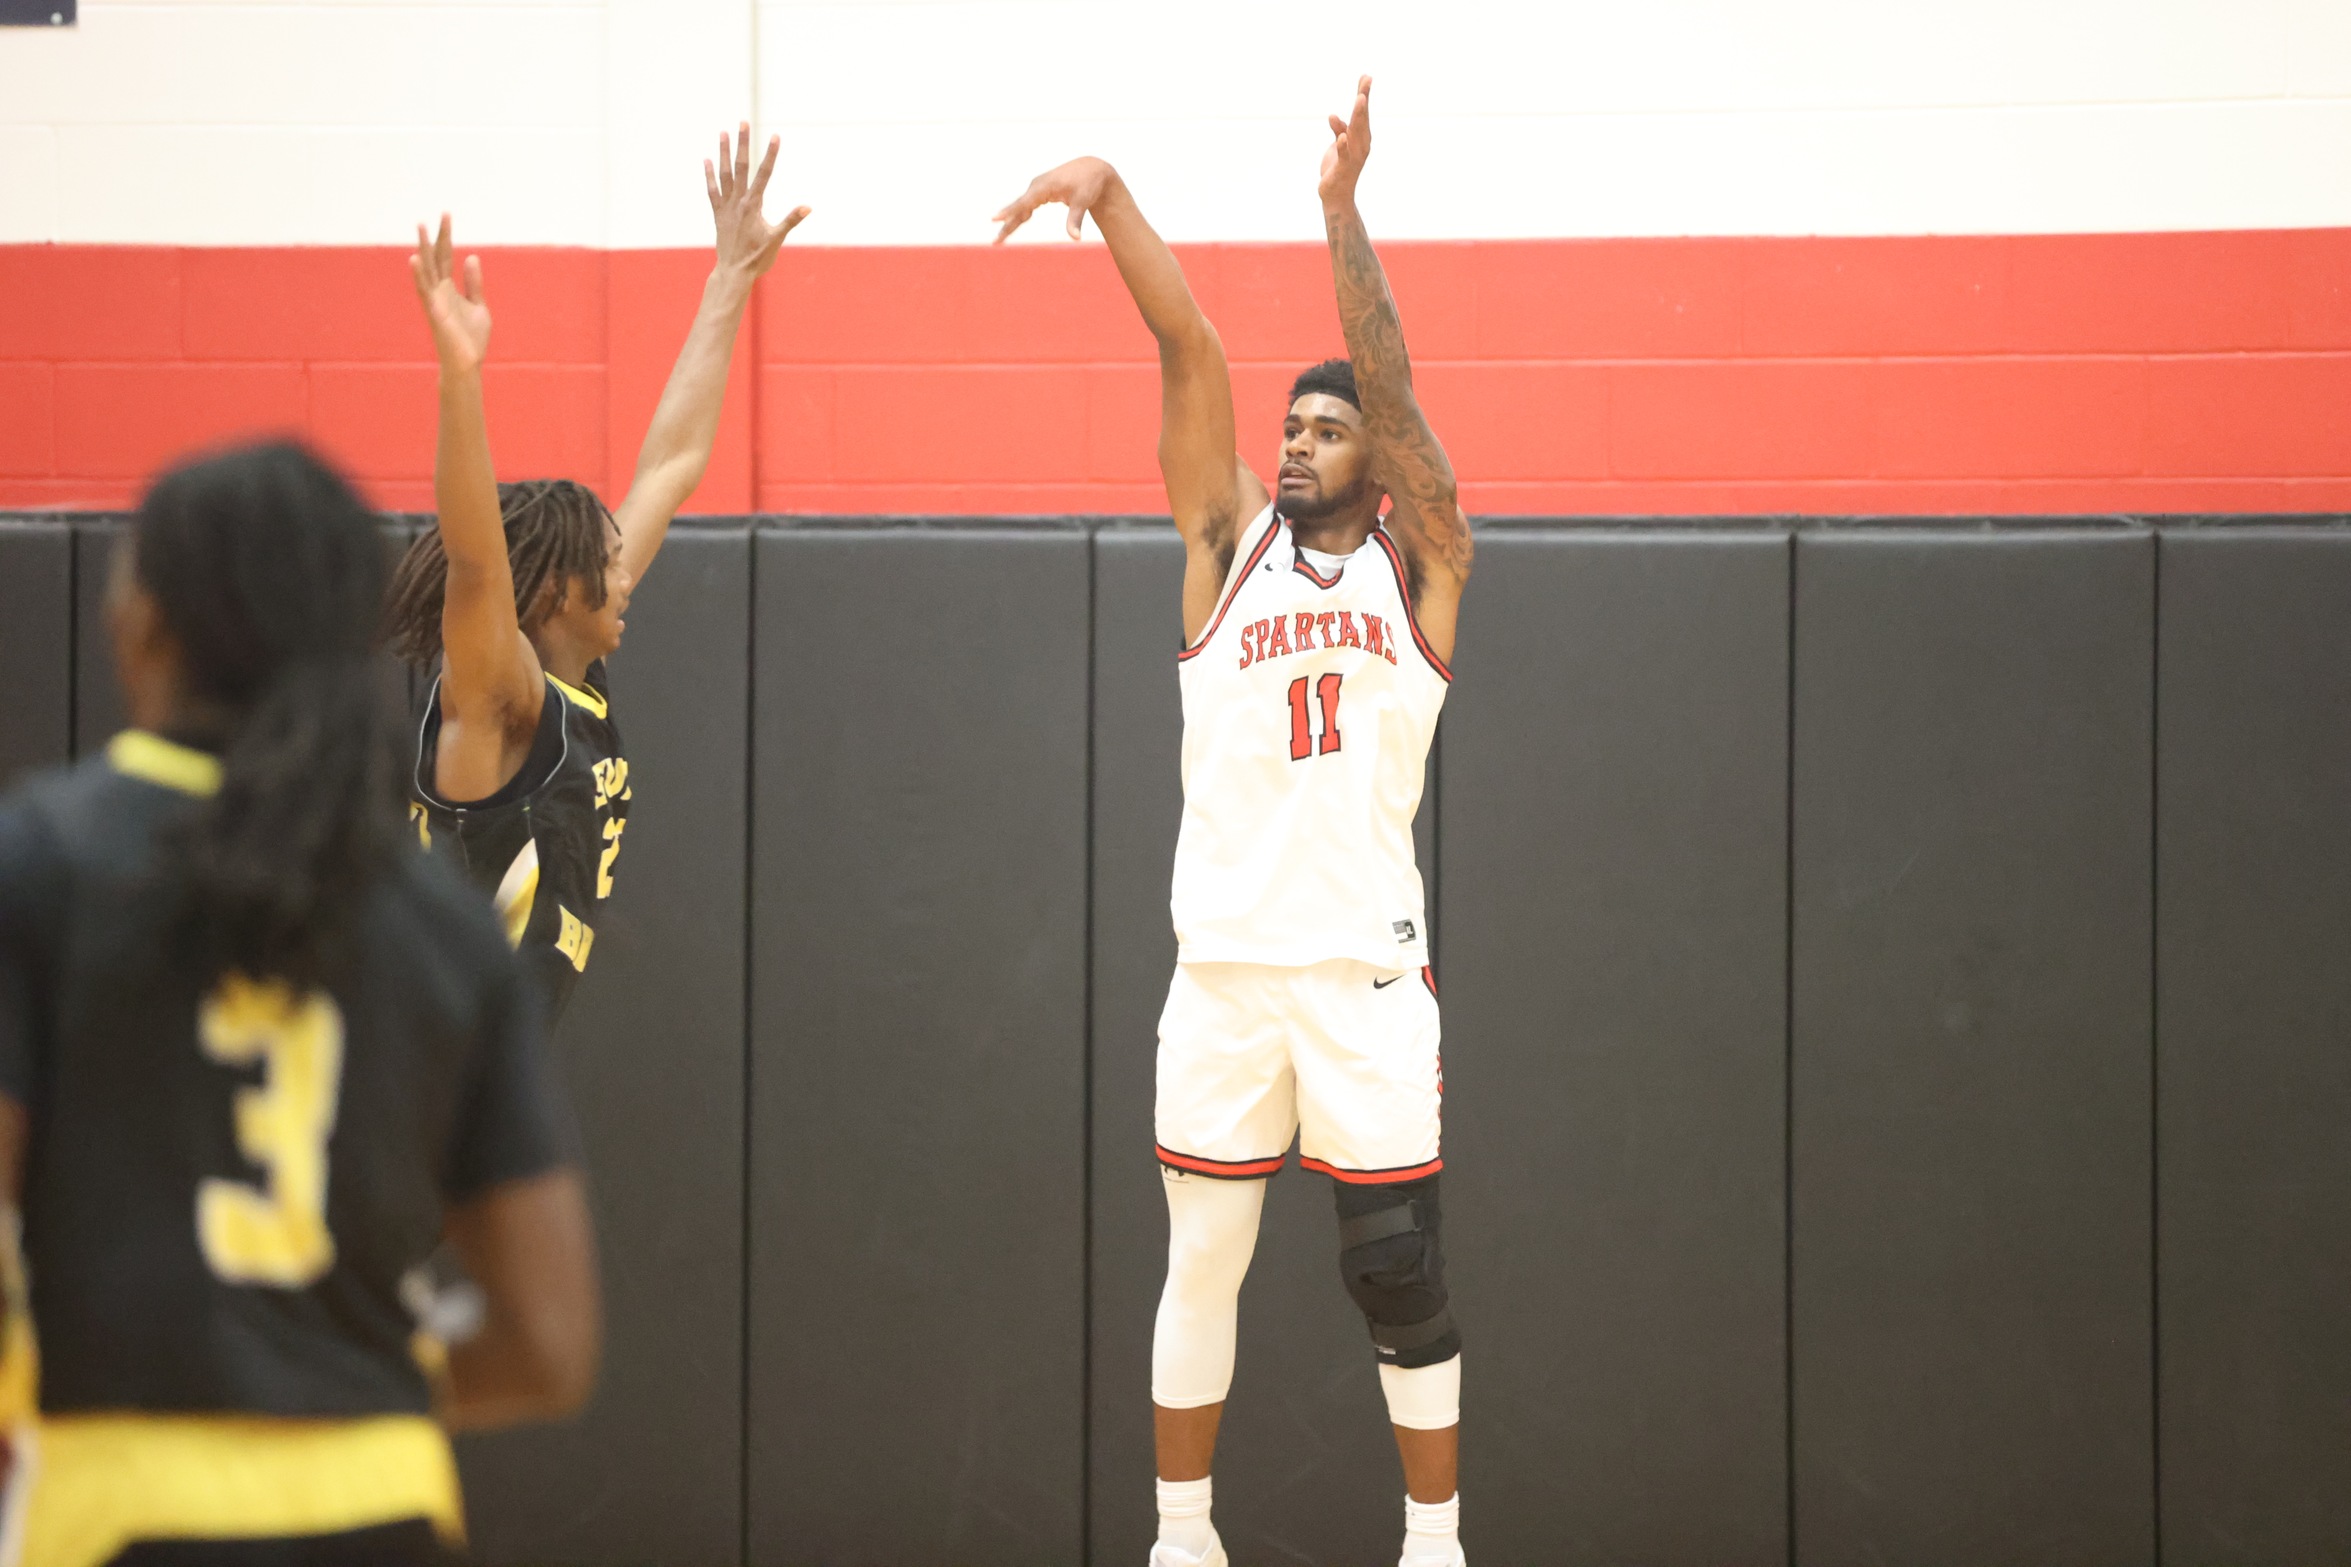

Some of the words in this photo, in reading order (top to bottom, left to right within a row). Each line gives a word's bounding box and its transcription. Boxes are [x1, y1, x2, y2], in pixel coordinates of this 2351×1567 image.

[1240, 610, 1398, 670] SPARTANS
[1287, 672, 1344, 762] 11
[197, 968, 345, 1290] 3
